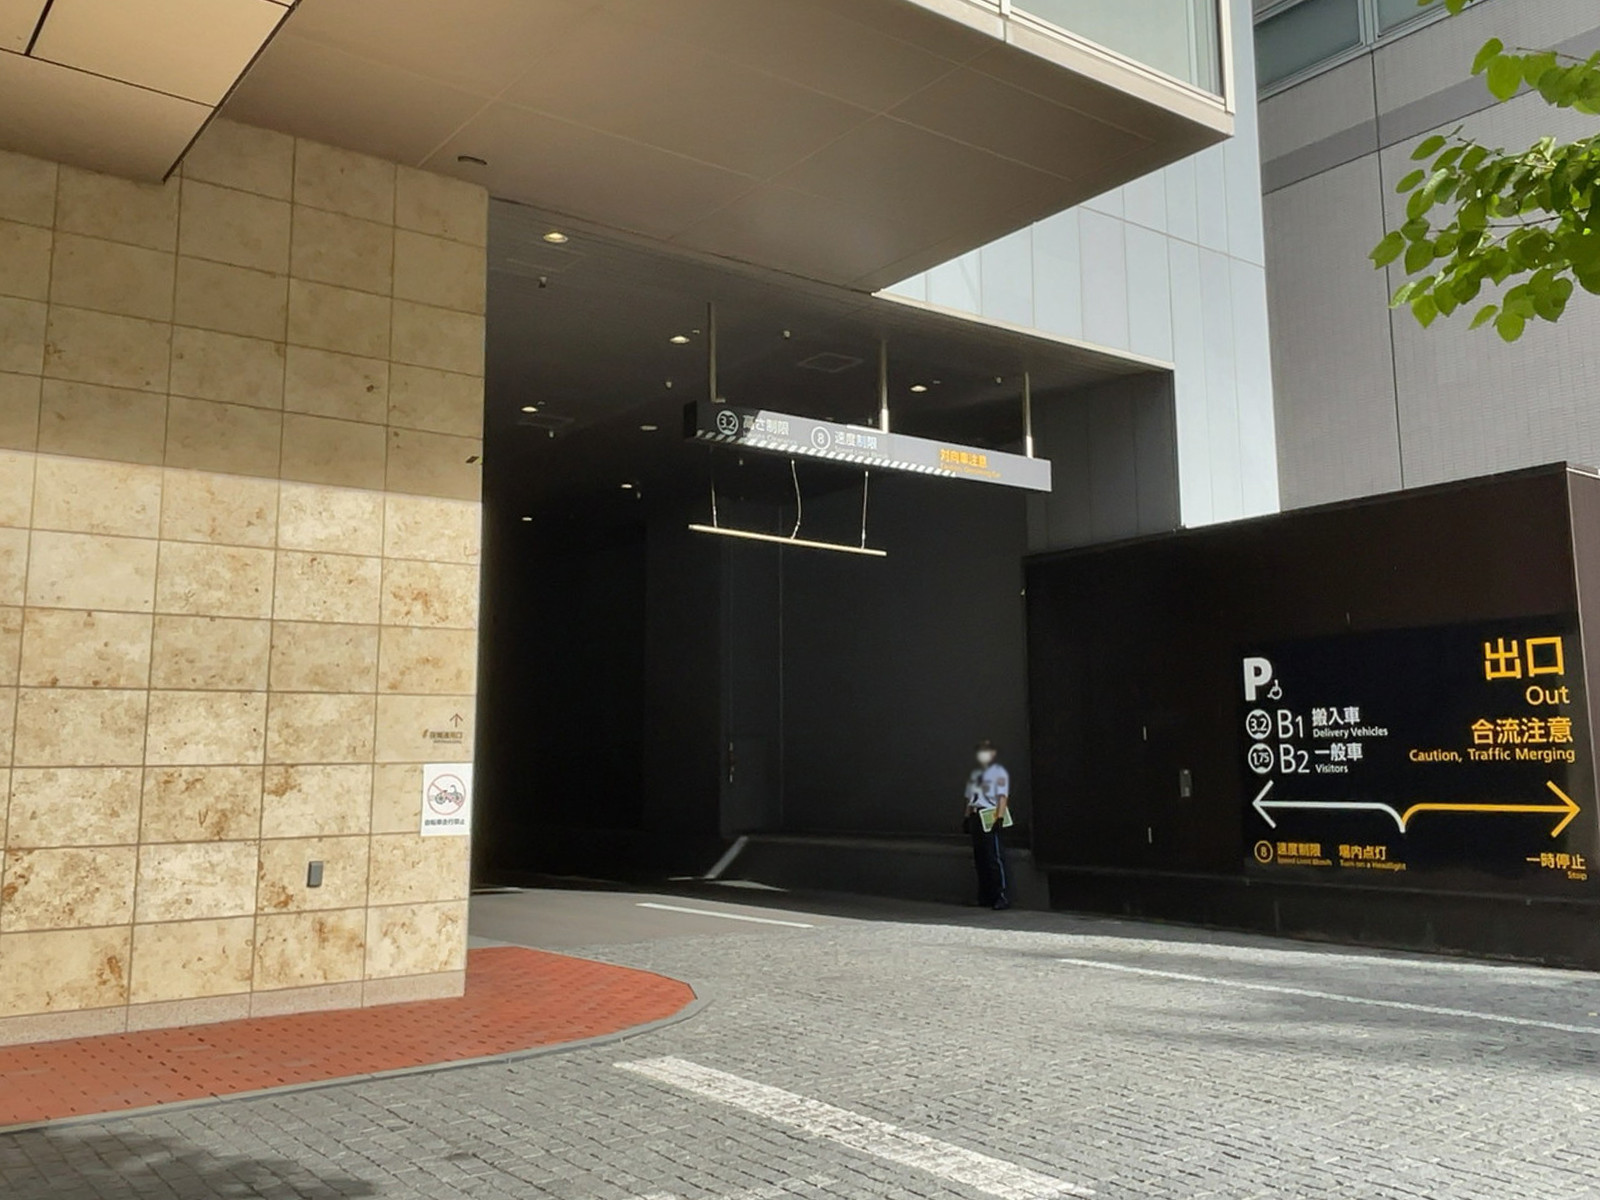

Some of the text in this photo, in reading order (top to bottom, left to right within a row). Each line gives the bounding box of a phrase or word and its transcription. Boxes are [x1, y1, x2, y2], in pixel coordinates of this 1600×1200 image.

[742, 414, 790, 437] 高さ制限
[834, 430, 878, 449] 速度制限
[1484, 636, 1565, 680] 出口
[1243, 657, 1273, 701] P
[1525, 685, 1571, 705] Out
[1277, 709, 1304, 739] B1
[1311, 706, 1361, 728] 搬入車
[1312, 726, 1389, 739] Delivery Vehicles
[1471, 716, 1574, 745] 合流注意
[1279, 743, 1311, 774] B2
[1314, 742, 1364, 762] 一般車
[1408, 747, 1576, 764] Caution, Traffic Merging
[1315, 763, 1350, 774] Visitors
[1525, 852, 1587, 870] 一時停止
